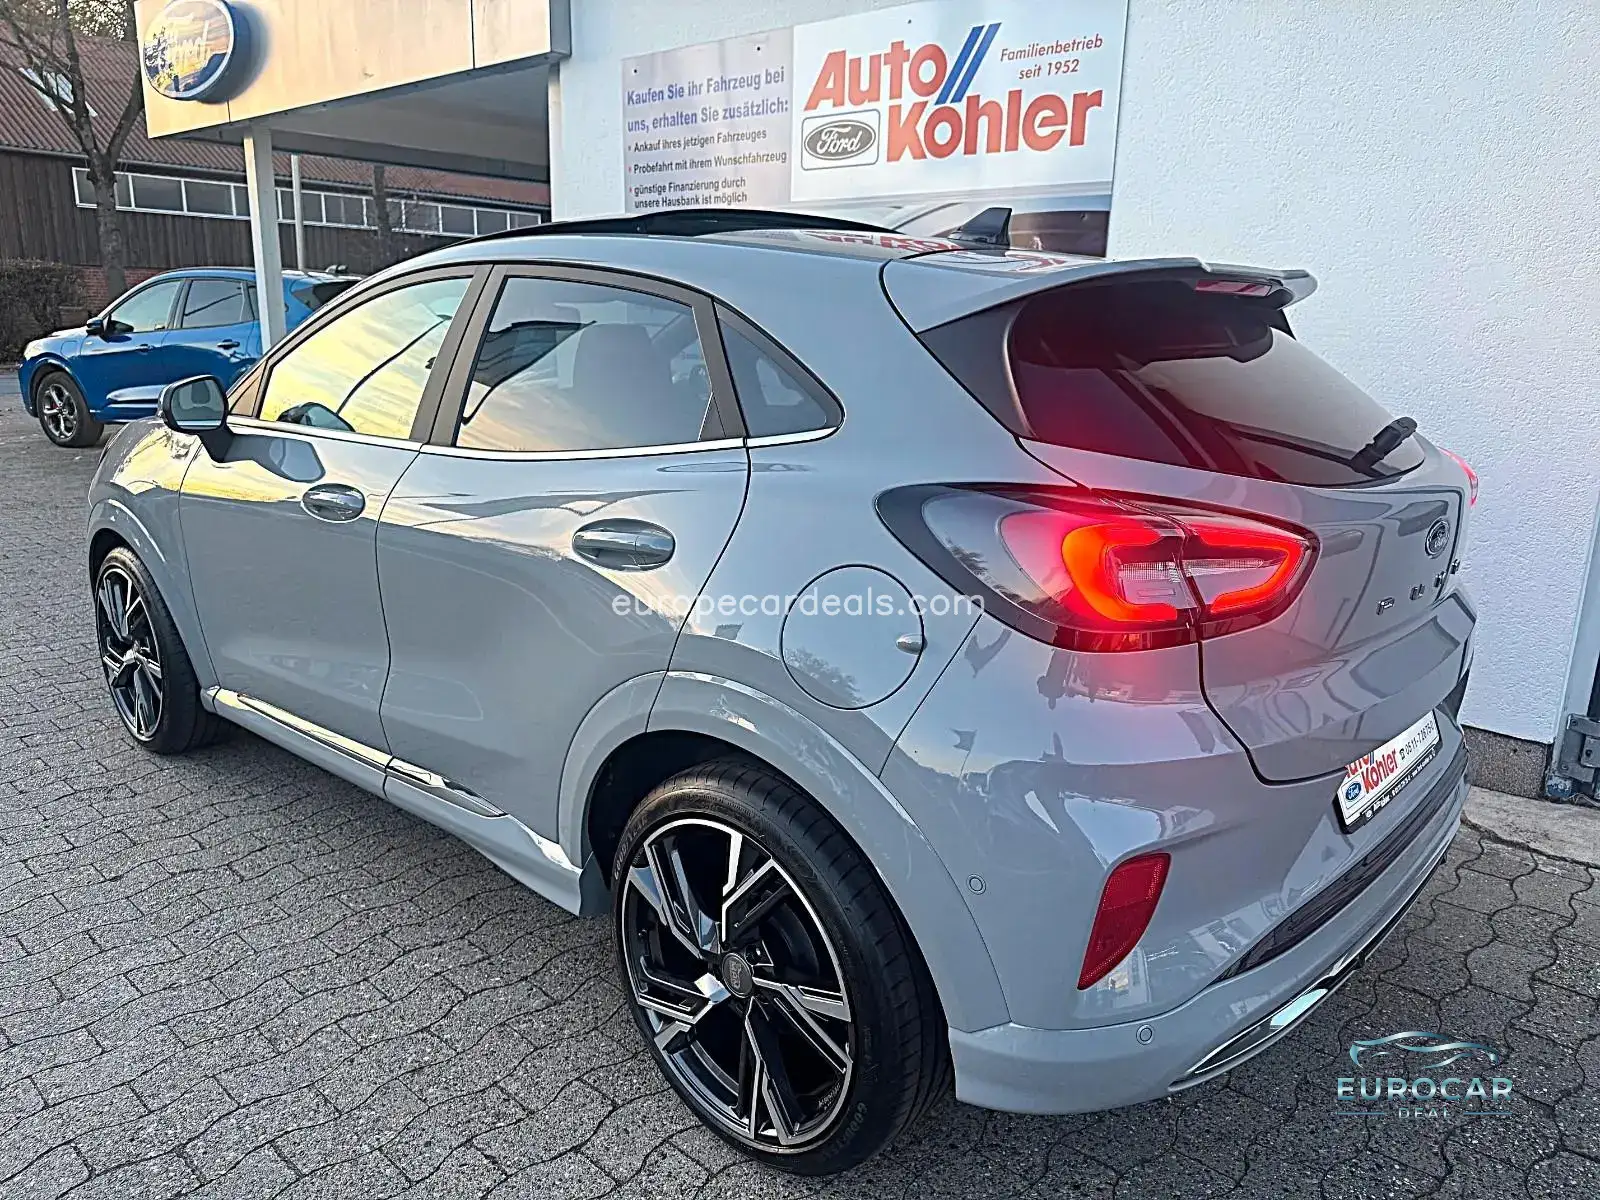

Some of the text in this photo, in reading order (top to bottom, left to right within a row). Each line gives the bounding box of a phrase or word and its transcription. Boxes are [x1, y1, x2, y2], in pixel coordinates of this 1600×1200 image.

[1000, 34, 1103, 62] Familienbetrieb
[804, 40, 948, 112] Auto
[1018, 58, 1080, 80] seit 1952
[627, 66, 785, 105] Kaufen Sie ihr Fahrzeug bei
[627, 97, 789, 133] uns, erhalten Sie zusätzlich:
[634, 129, 767, 152] Ankauf ihres jetzigen Fahrzeuges
[816, 127, 861, 154] Ford
[634, 151, 787, 174] Probefahrt mit ihrem Wunschfahrzeug
[634, 177, 746, 197] günstige Finanzierung durch
[634, 192, 748, 209] unsere Hausbank ist möglich
